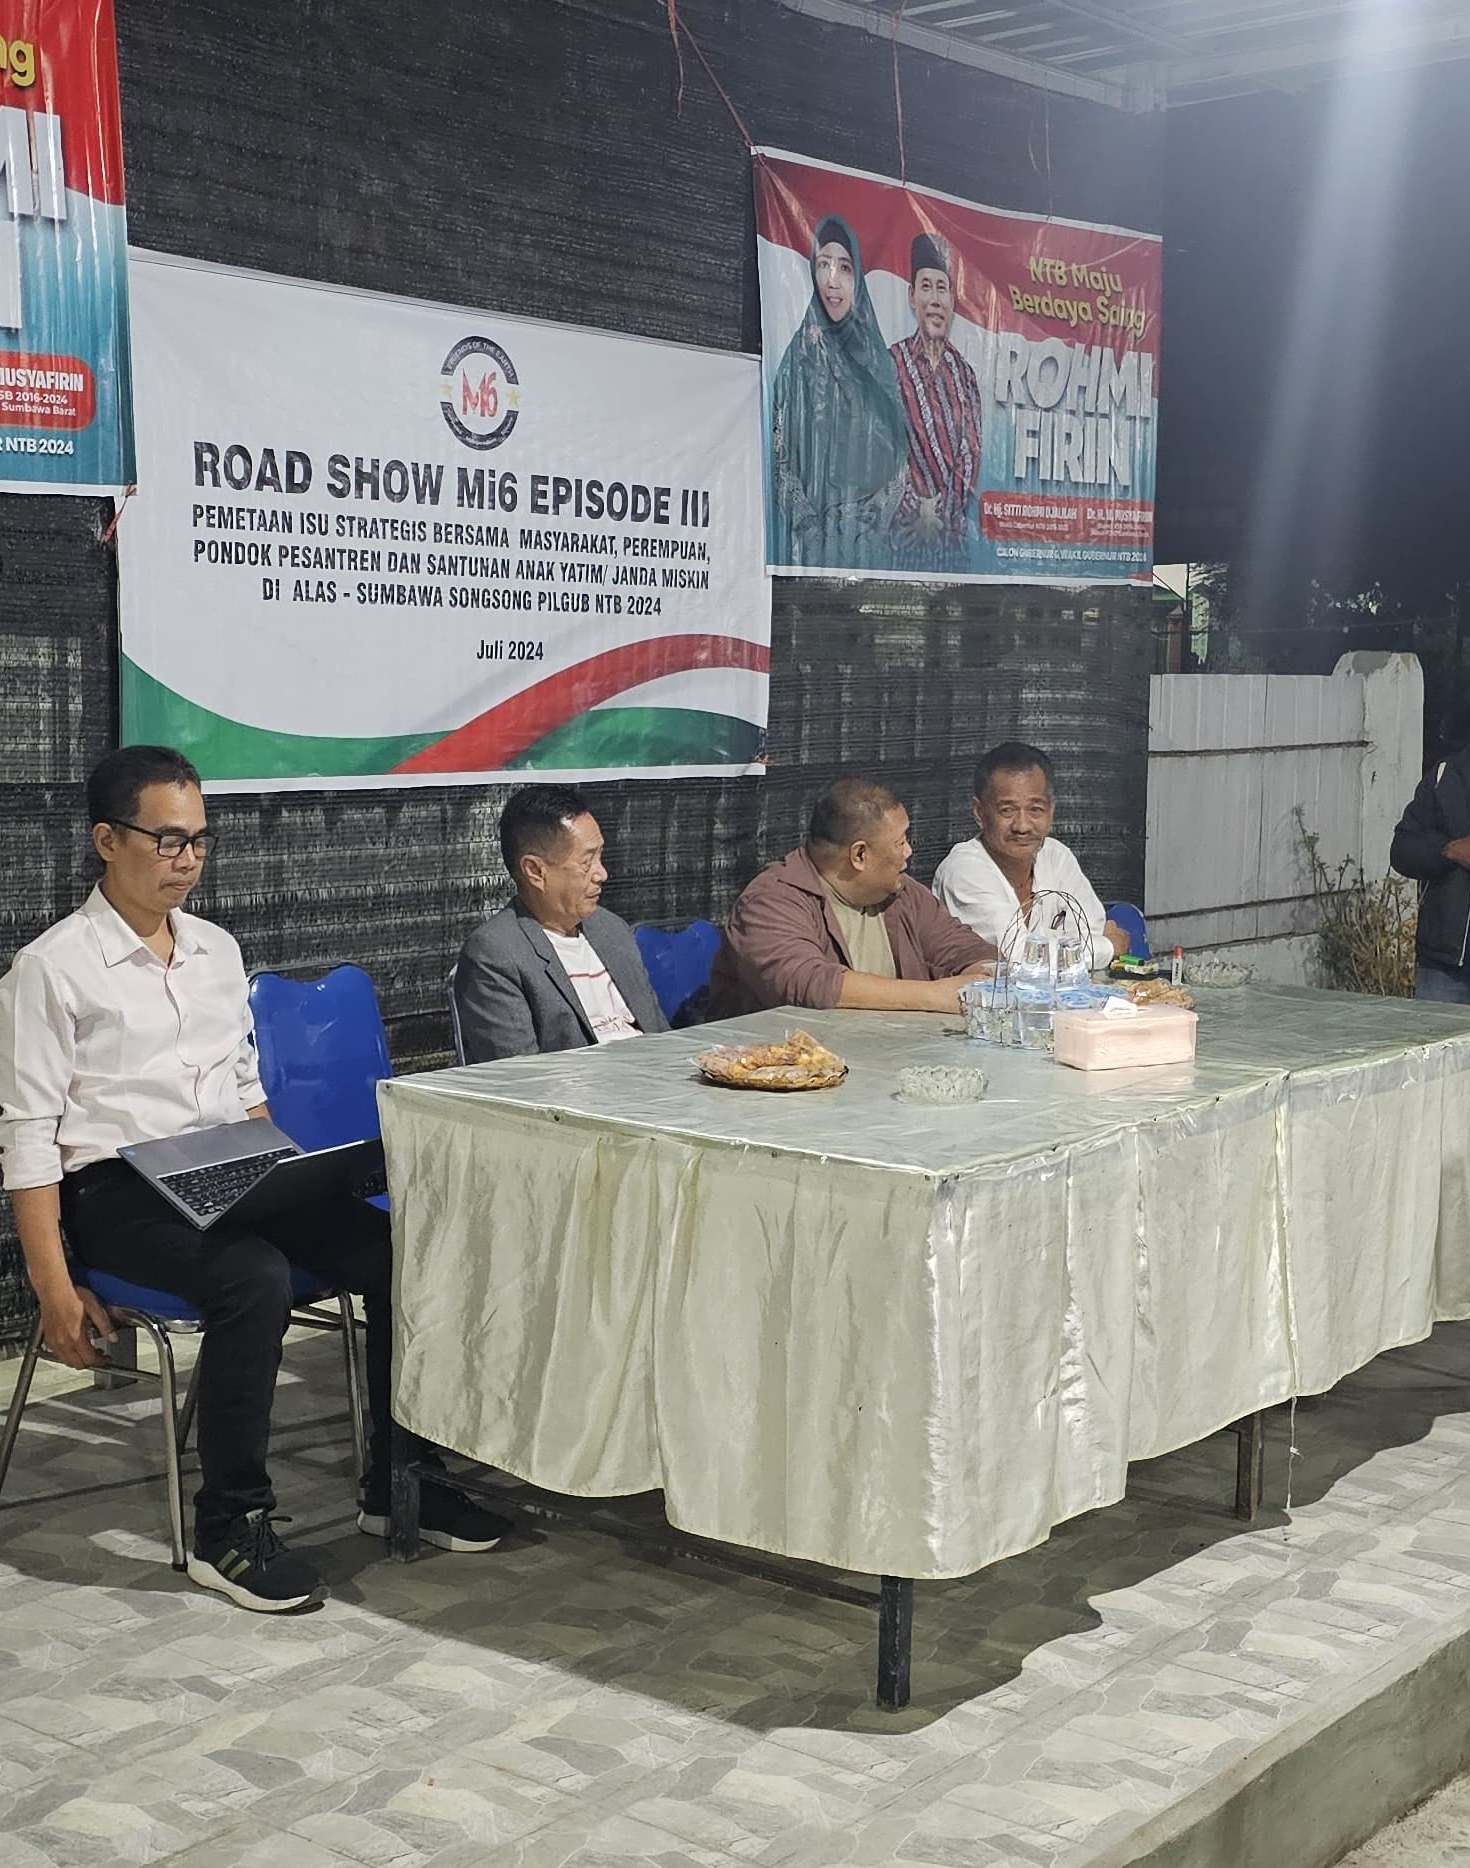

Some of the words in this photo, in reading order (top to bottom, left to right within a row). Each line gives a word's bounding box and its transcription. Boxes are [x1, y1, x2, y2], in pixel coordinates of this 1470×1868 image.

[1028, 255, 1067, 285] NTB
[1071, 261, 1123, 301] Maju
[1009, 284, 1093, 328] Berdaya
[1098, 295, 1146, 338] Saing
[0, 367, 84, 392] USYAFIRIN
[15, 391, 68, 405] 2016-2024
[995, 332, 1153, 418] ROHMI
[1, 401, 51, 414] Sumbawa
[52, 405, 76, 416] Barat
[5, 436, 37, 453] NTB
[38, 438, 75, 455] 2024
[1014, 408, 1130, 487] FIRIN
[193, 441, 313, 494] ROAD
[326, 454, 444, 506] SHOW
[456, 466, 518, 512] Mi6
[530, 474, 671, 525] EPISODE
[681, 489, 710, 528] III
[192, 504, 293, 533] PEMETAAN
[300, 512, 329, 536] ISU
[335, 514, 427, 542] STRATEGIS
[433, 522, 509, 548] BERSAMA
[519, 528, 618, 558] MASYARAKAT,
[622, 536, 711, 565] PEREMPUAN,
[193, 539, 272, 567] PONDOK
[278, 545, 381, 572] PESANTREN
[387, 552, 421, 574] DAN
[427, 554, 510, 579] SANTUNAN
[515, 559, 555, 581] ANAK
[611, 565, 657, 587] JANDA
[661, 568, 709, 590] MISKIN
[262, 578, 281, 600] DI
[292, 579, 337, 604] ALAS
[357, 582, 443, 607] SUMBAWA
[449, 586, 532, 611] SONGSONG
[537, 591, 590, 613] PILGUB
[595, 594, 622, 614] NTB
[627, 596, 662, 616] 2024
[476, 640, 503, 661] Juli
[508, 641, 544, 661] 2024
